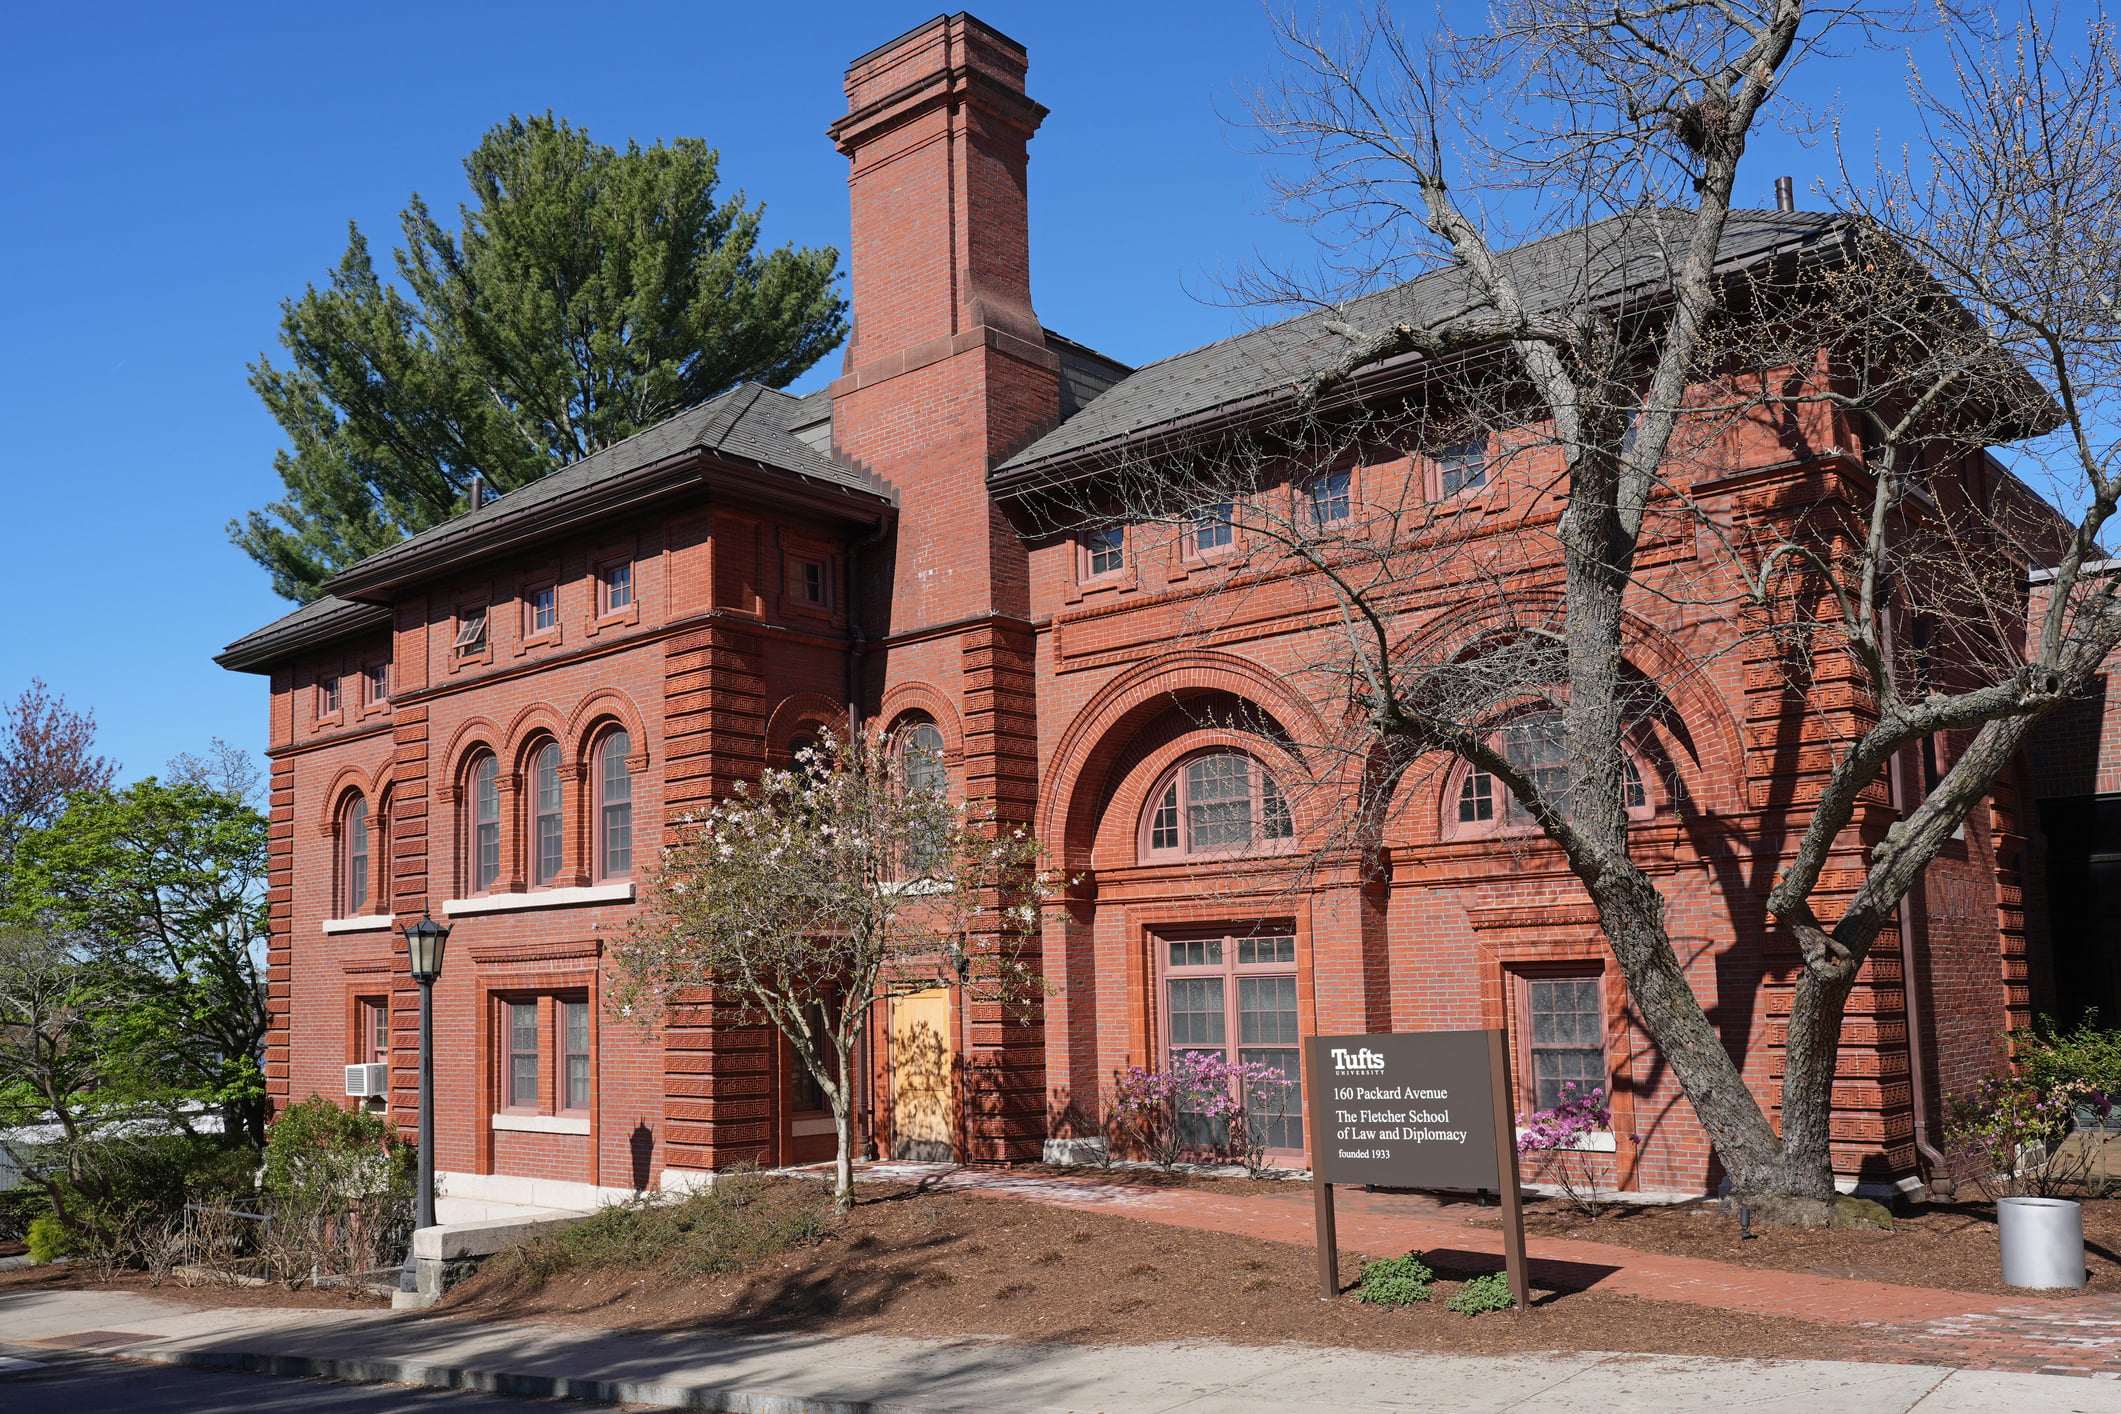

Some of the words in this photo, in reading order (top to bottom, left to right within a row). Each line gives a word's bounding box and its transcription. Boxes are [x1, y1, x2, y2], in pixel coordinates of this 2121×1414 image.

[1331, 1048, 1385, 1069] Tufts
[1334, 1088, 1353, 1100] 160
[1356, 1086, 1401, 1099] Packard
[1404, 1087, 1448, 1099] Avenue
[1336, 1110, 1357, 1122] The
[1360, 1110, 1406, 1122] Fletcher
[1409, 1110, 1449, 1123] School
[1337, 1127, 1350, 1139] of
[1352, 1127, 1376, 1139] Law
[1379, 1127, 1400, 1140] and
[1403, 1127, 1467, 1144] Diplomacy
[1339, 1149, 1369, 1158] founded
[1372, 1150, 1390, 1159] 1933
